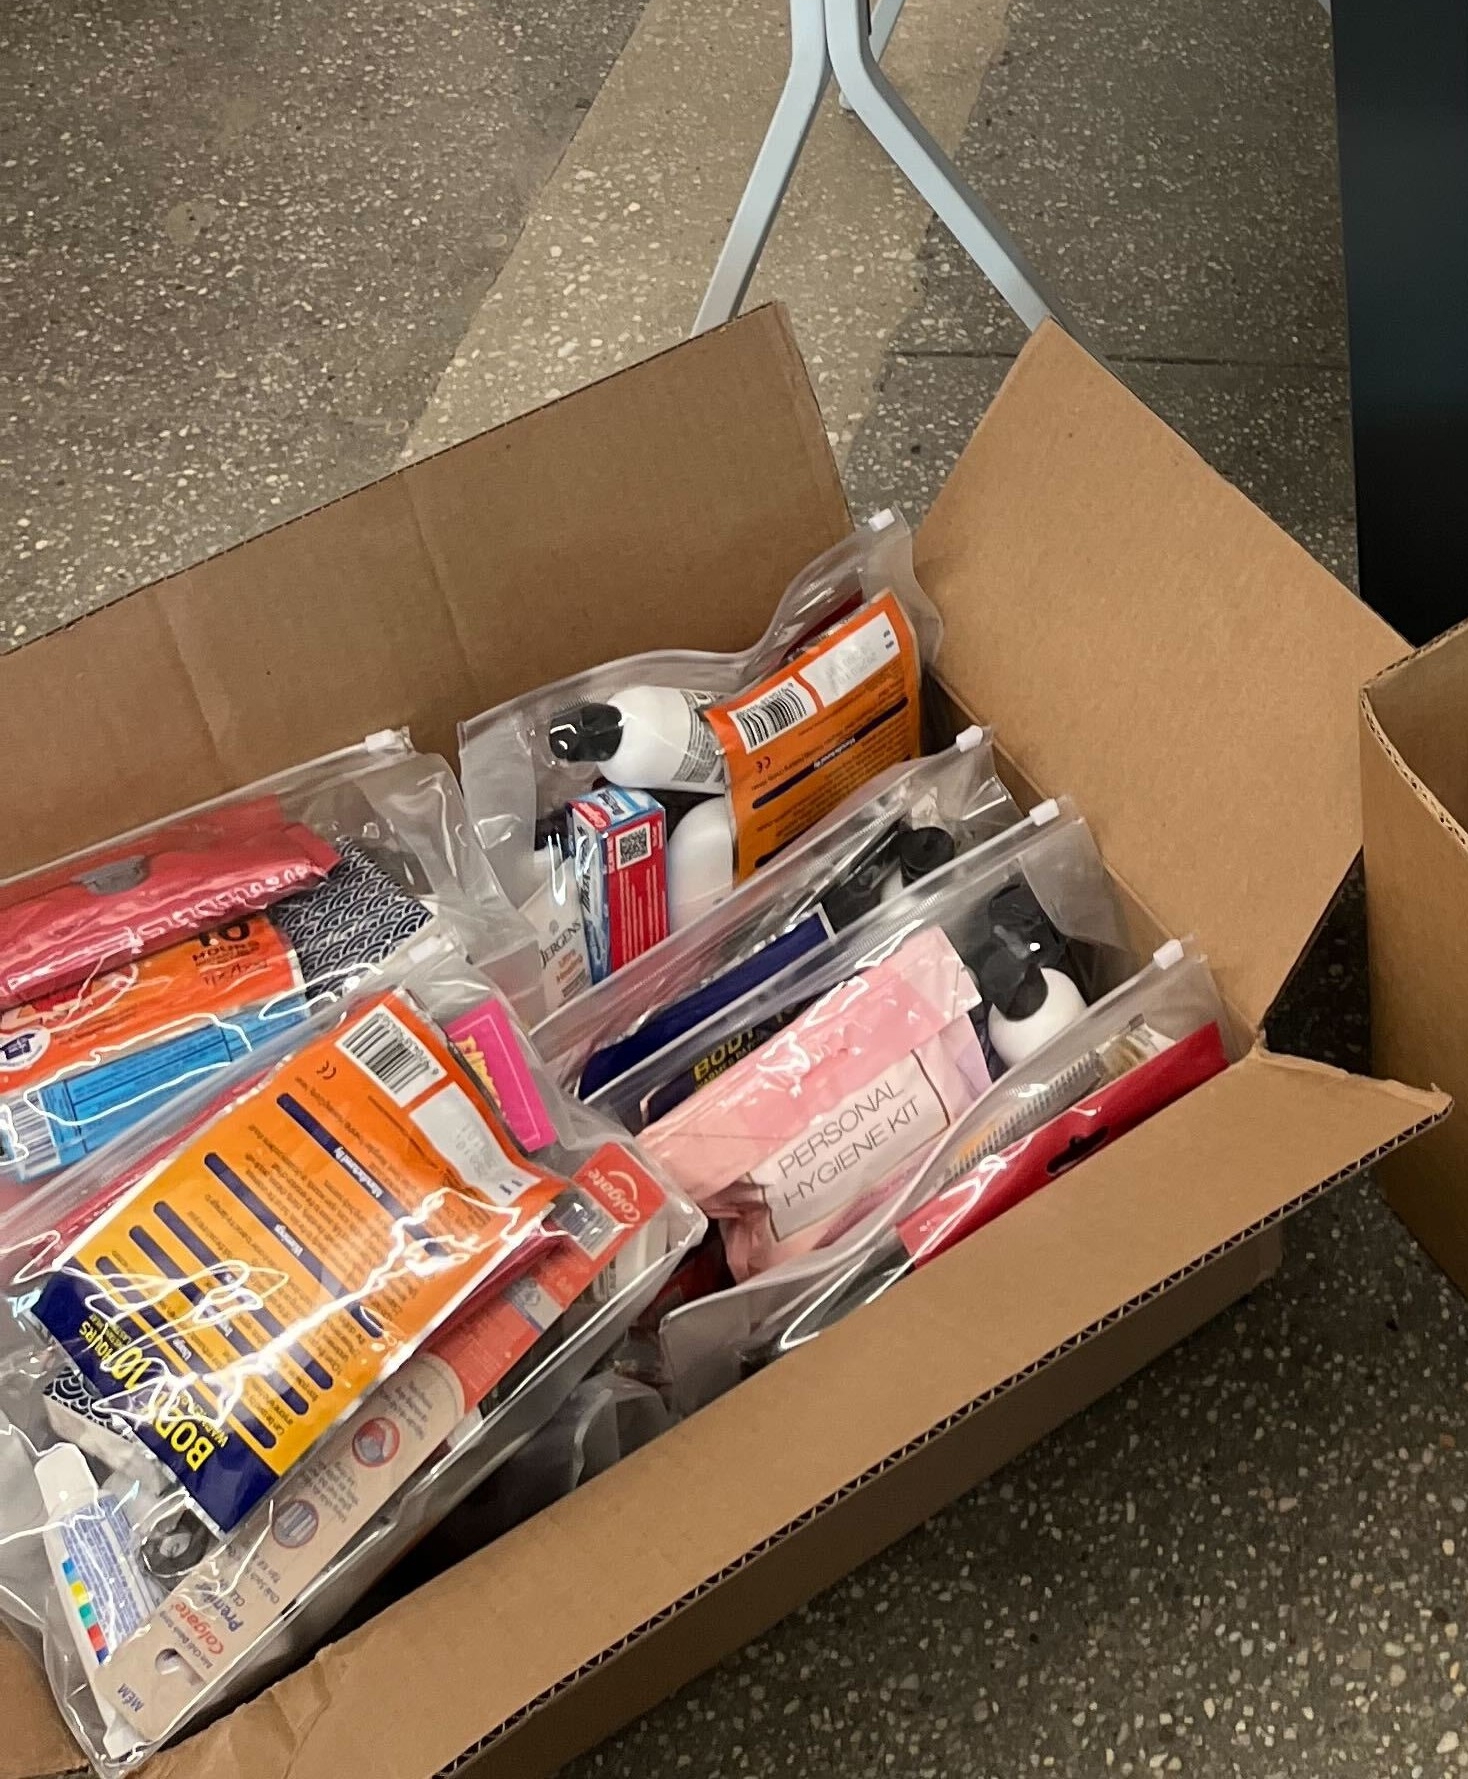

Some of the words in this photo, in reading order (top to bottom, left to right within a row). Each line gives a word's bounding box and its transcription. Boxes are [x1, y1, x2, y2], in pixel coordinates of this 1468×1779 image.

[777, 1079, 906, 1179] PERSONAL
[782, 1124, 886, 1209] HYGIENE
[885, 1098, 923, 1143] KIT
[583, 1165, 644, 1224] Colgate
[74, 1317, 117, 1362] HOURS
[105, 1341, 157, 1393] 10
[170, 1601, 227, 1654] Colgate
